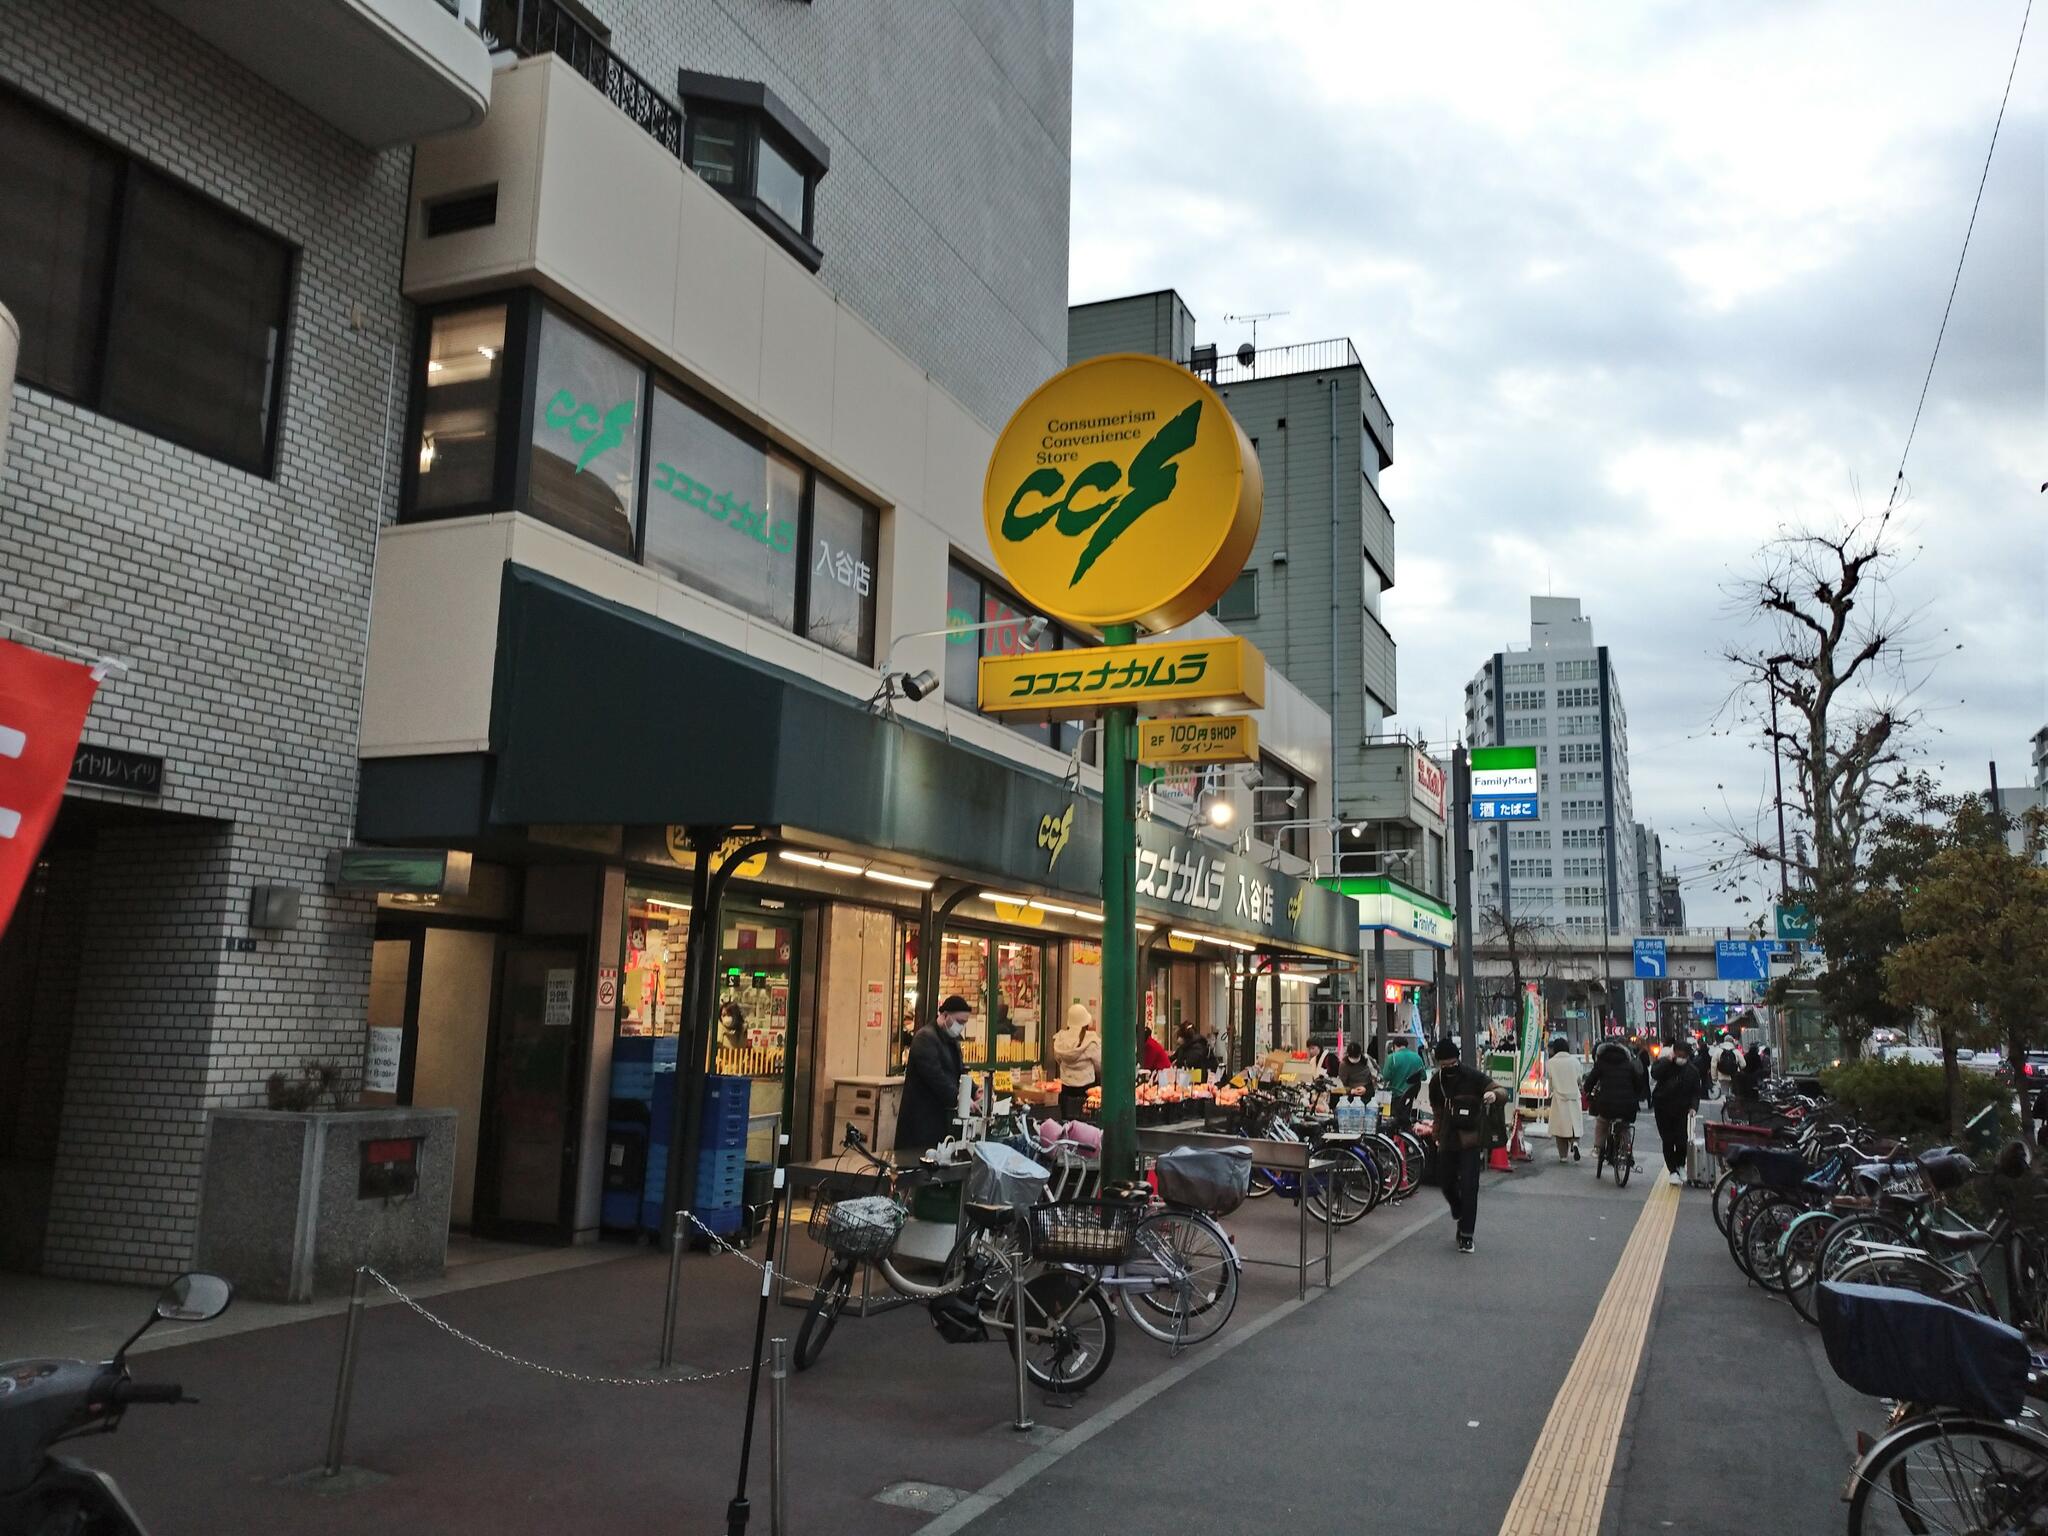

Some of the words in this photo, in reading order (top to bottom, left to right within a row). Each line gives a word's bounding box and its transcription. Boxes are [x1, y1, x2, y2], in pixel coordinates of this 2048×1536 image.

[1048, 410, 1156, 434] Consumerism
[1042, 428, 1141, 449] Convenience
[1036, 451, 1078, 465] Store
[654, 462, 794, 554] ココスナカムラ
[814, 539, 871, 598] 入谷店
[1010, 653, 1209, 696] ココスナカムラ
[1150, 735, 1165, 747] 2F
[1170, 725, 1208, 743] 100円
[1210, 725, 1237, 741] SHOP
[1180, 742, 1224, 753] ダイソー
[1474, 776, 1533, 788] FamilyMart
[1480, 802, 1495, 817] 酒
[1500, 803, 1532, 815] たばこ
[1136, 846, 1226, 912] スナカムラ
[1235, 874, 1274, 926] 入谷店
[1720, 942, 1747, 951] 日本橋
